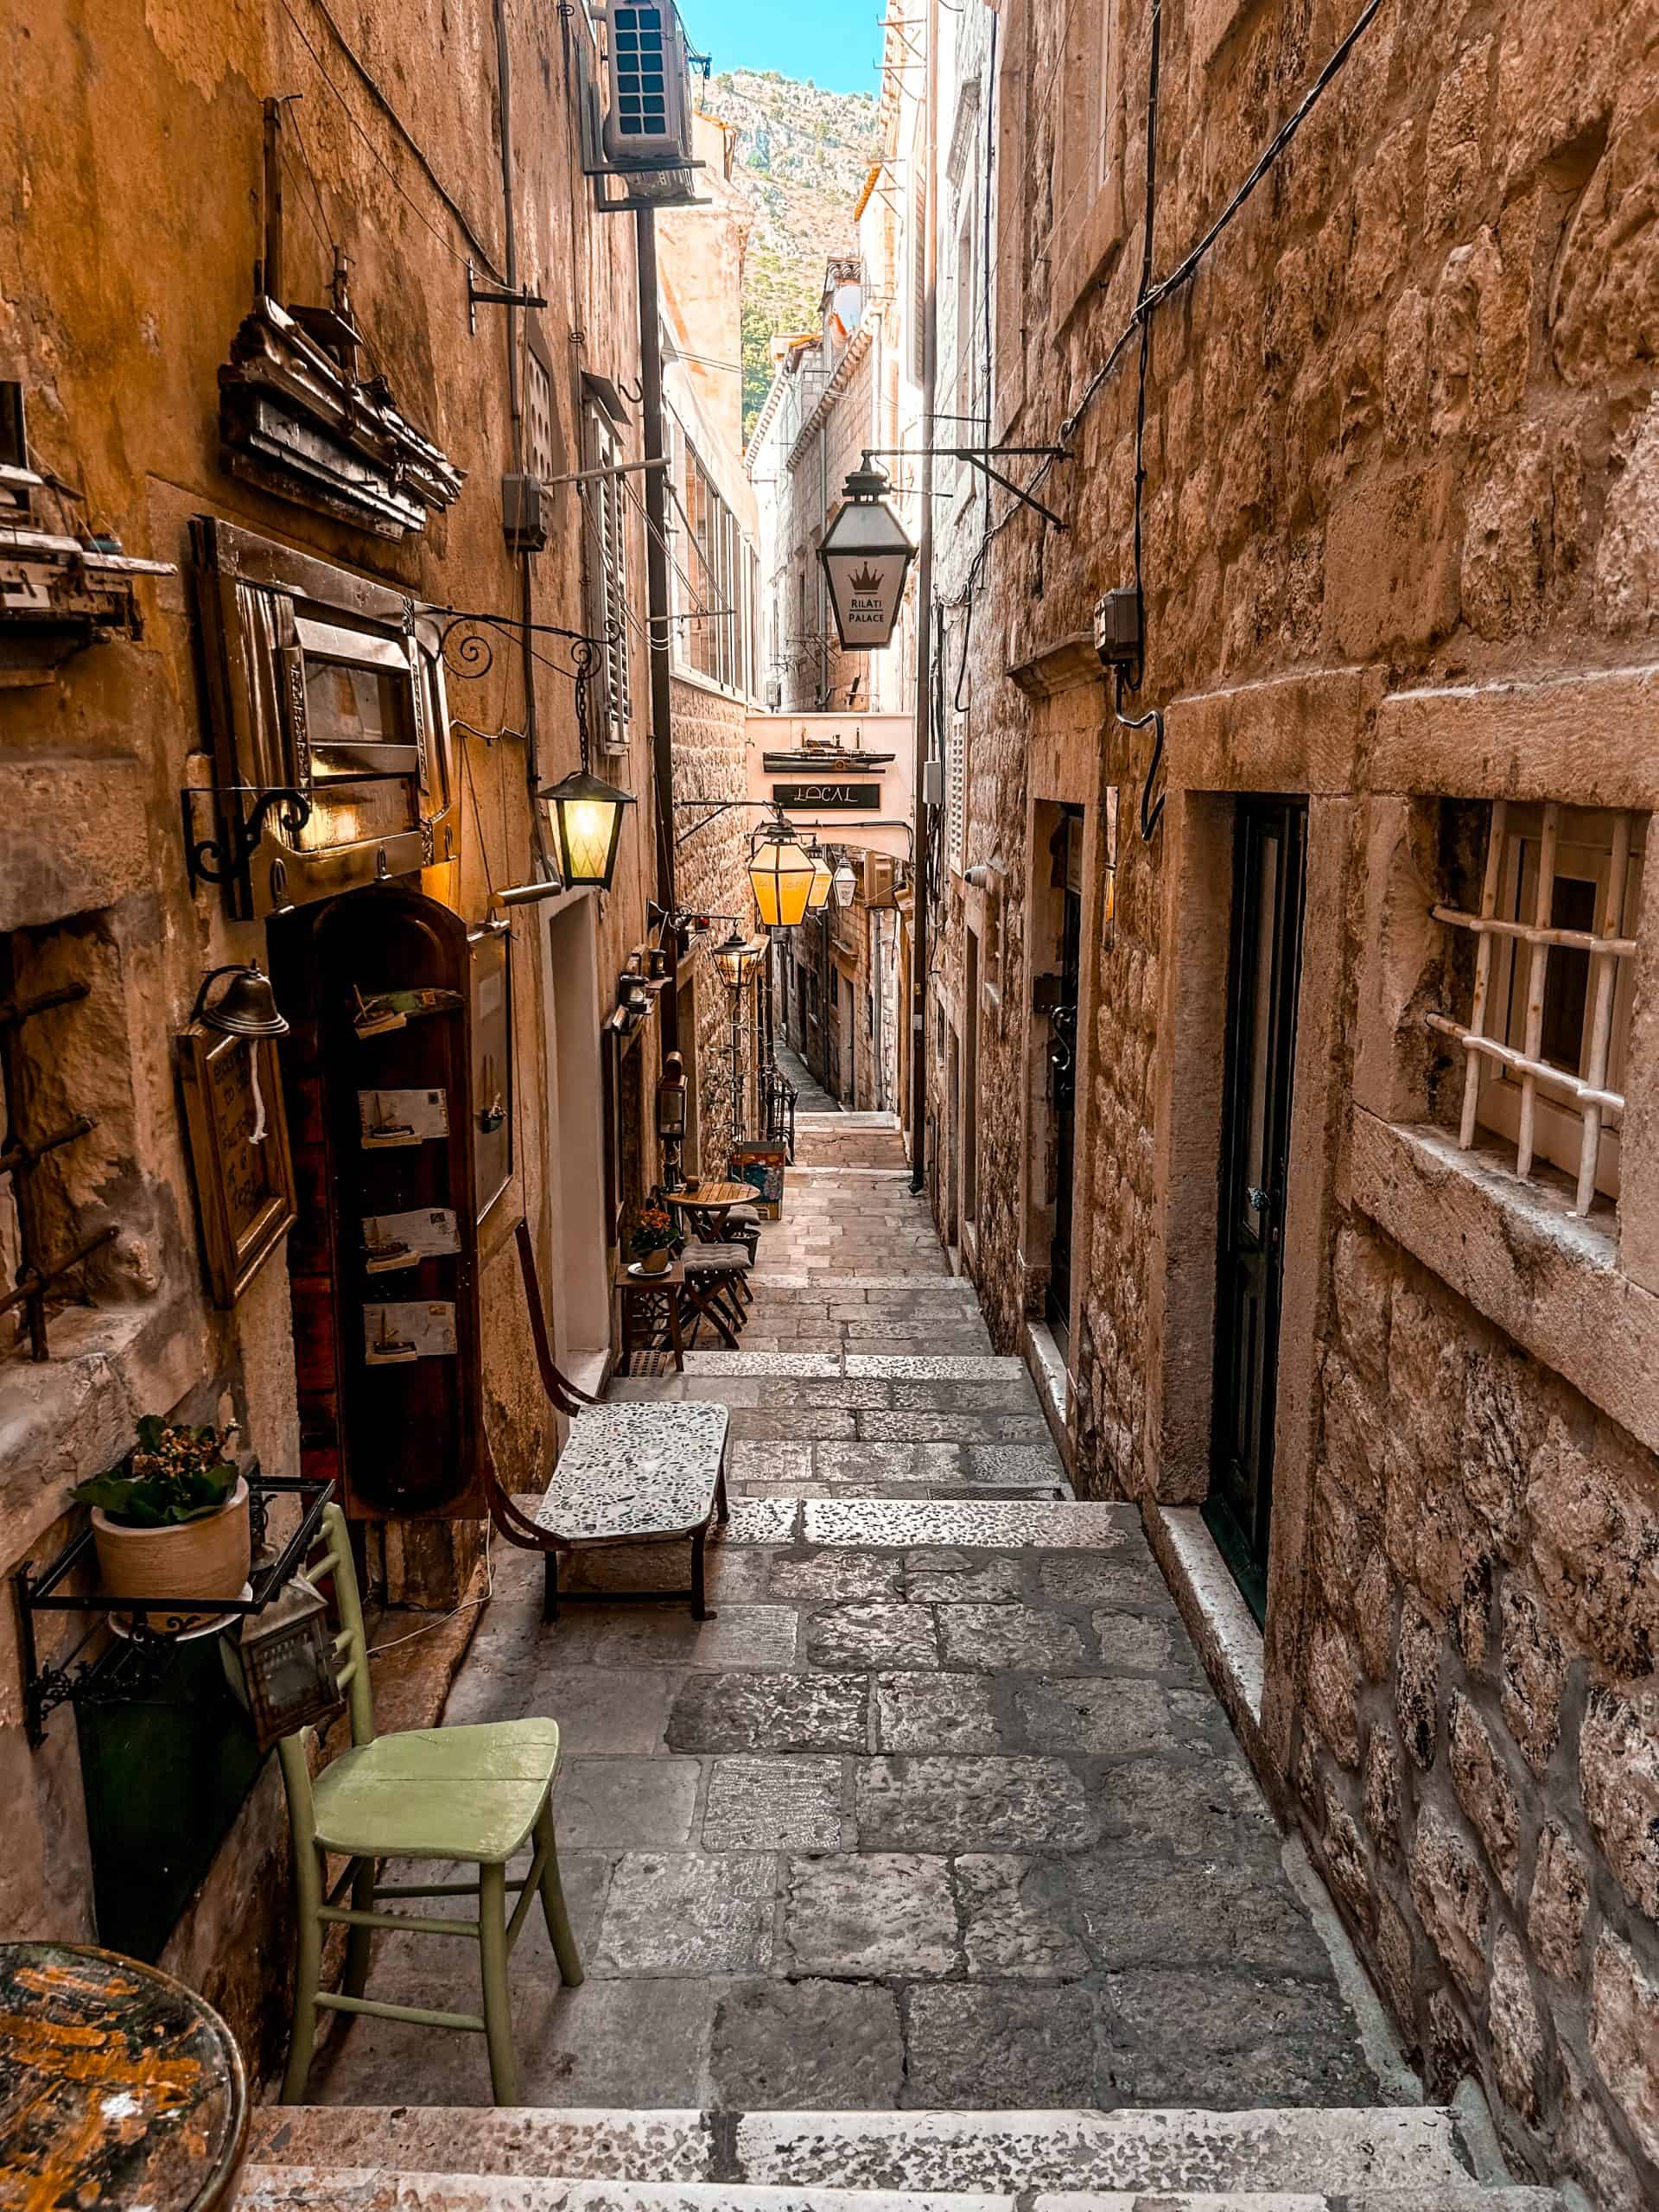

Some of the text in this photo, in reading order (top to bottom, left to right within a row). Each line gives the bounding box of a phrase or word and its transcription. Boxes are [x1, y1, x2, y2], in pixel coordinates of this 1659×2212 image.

[851, 599, 882, 608] RILATI
[849, 613, 884, 622] PALACE
[793, 786, 858, 803] LOCAL
